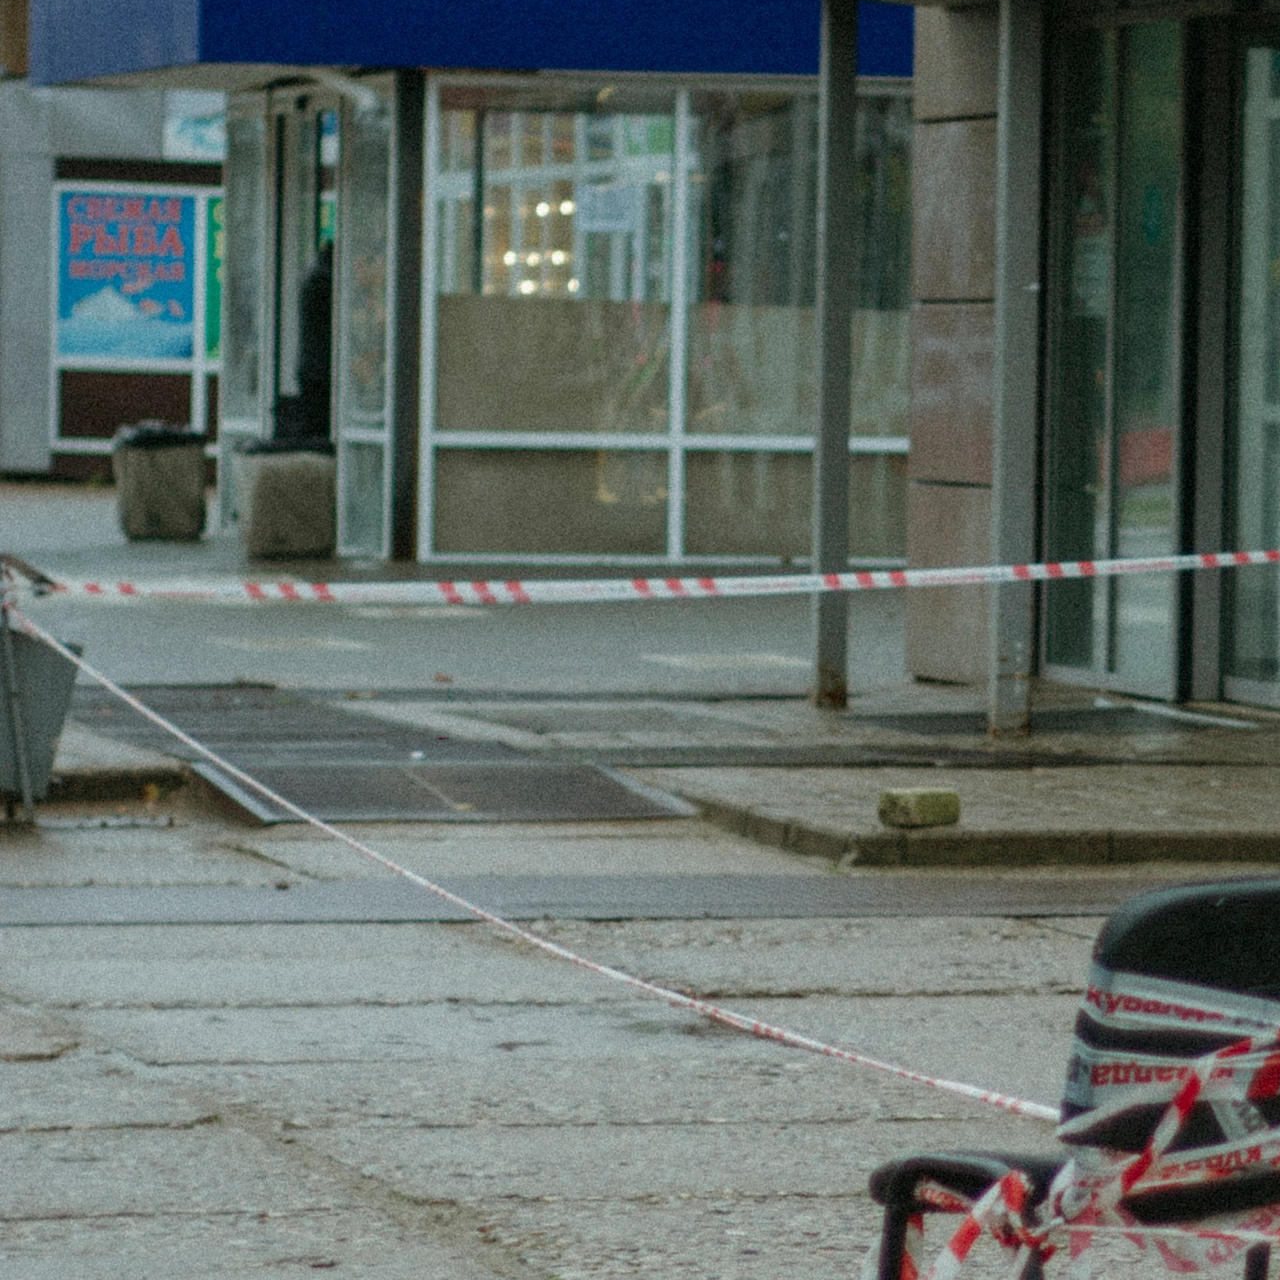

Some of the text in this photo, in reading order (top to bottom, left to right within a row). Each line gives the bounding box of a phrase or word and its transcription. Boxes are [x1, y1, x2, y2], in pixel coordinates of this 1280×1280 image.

[67, 195, 182, 222] СВЕЖАЯ
[69, 223, 185, 257] РЫБА
[69, 260, 185, 281] МОРСКАЯ
